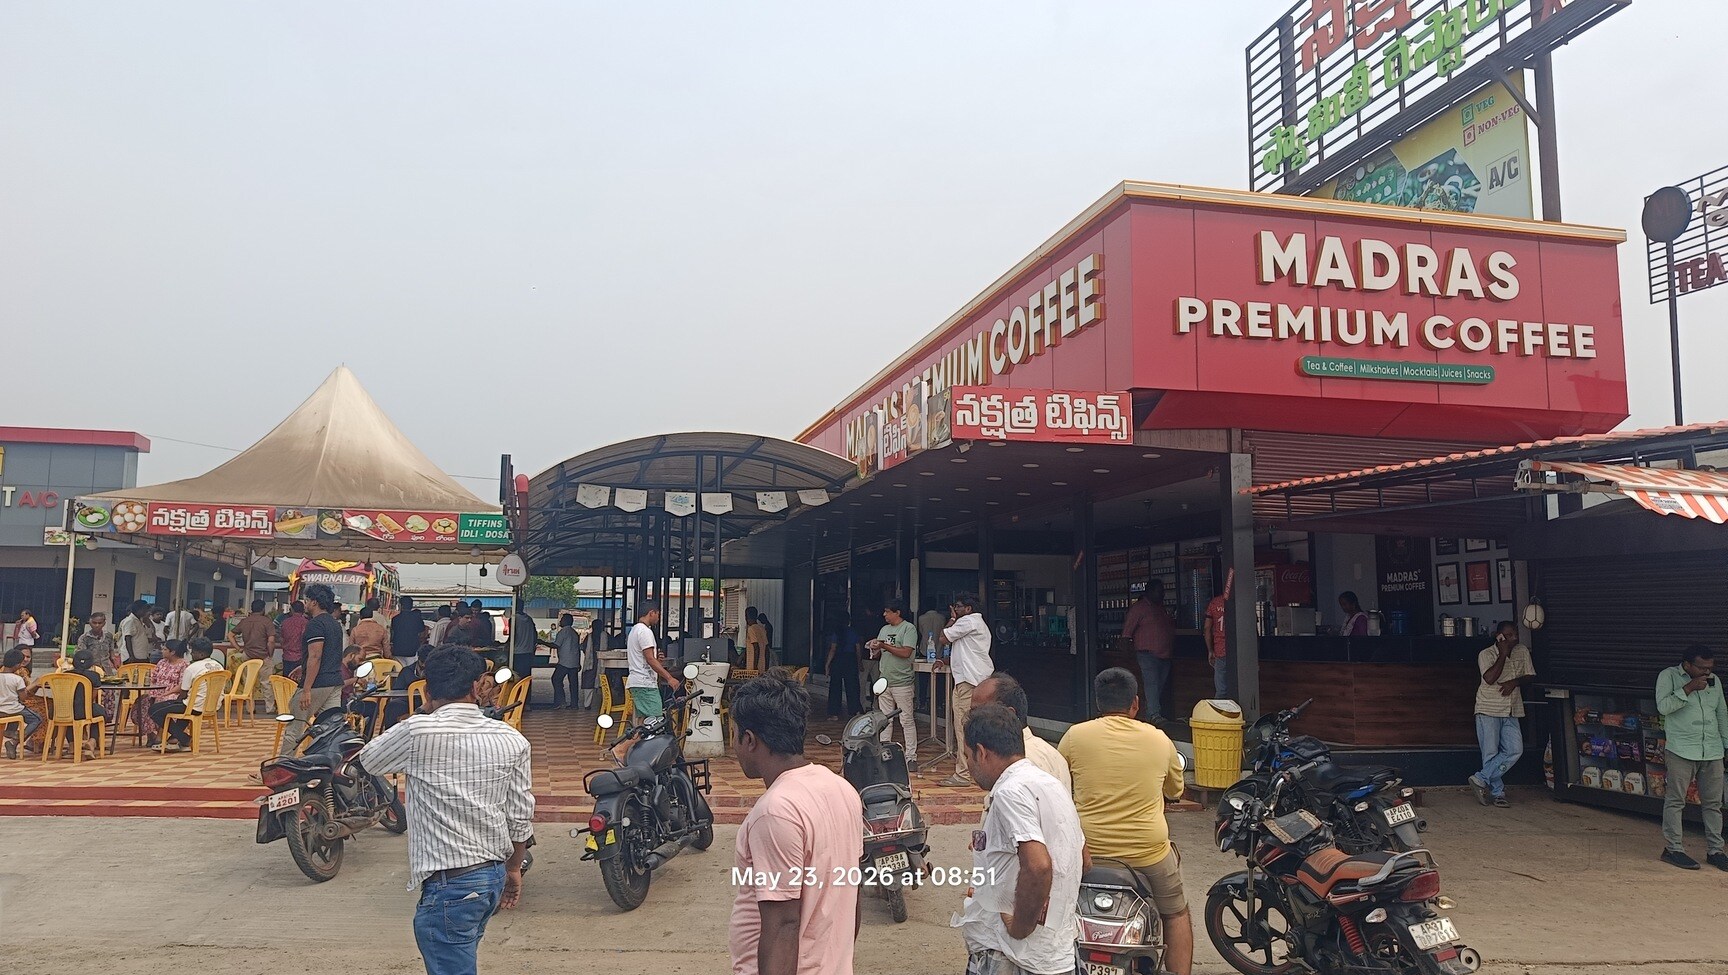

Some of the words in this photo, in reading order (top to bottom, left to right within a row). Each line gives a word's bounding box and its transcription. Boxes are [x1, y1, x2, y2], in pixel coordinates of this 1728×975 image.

[1475, 95, 1496, 113] VEG
[1477, 104, 1520, 135] NON-VEG
[1488, 156, 1519, 190] A/C
[1259, 230, 1521, 301] MADRAS
[989, 253, 1099, 375] COFFEE
[1177, 297, 1410, 348] PREMIUM
[1422, 315, 1598, 359] COFFEE
[1306, 360, 1320, 370] Tea
[1329, 362, 1354, 373] Coffee
[1359, 364, 1399, 376] Milkshakes
[1402, 366, 1438, 377] Mocktails
[1440, 368, 1463, 379] Juices
[1466, 369, 1491, 380] Snacks
[956, 393, 1039, 440] నక్షత్ర
[18, 490, 59, 508] A/C
[152, 507, 210, 534] నక్షత్ర
[468, 519, 503, 528] TIFFINS
[460, 529, 479, 538] IDLI
[485, 530, 509, 539] DOSA
[1381, 583, 1404, 592] PREMIUM
[1405, 581, 1426, 591] COFFEE
[1386, 570, 1419, 583] MADRAS
[276, 796, 297, 808] 4201
